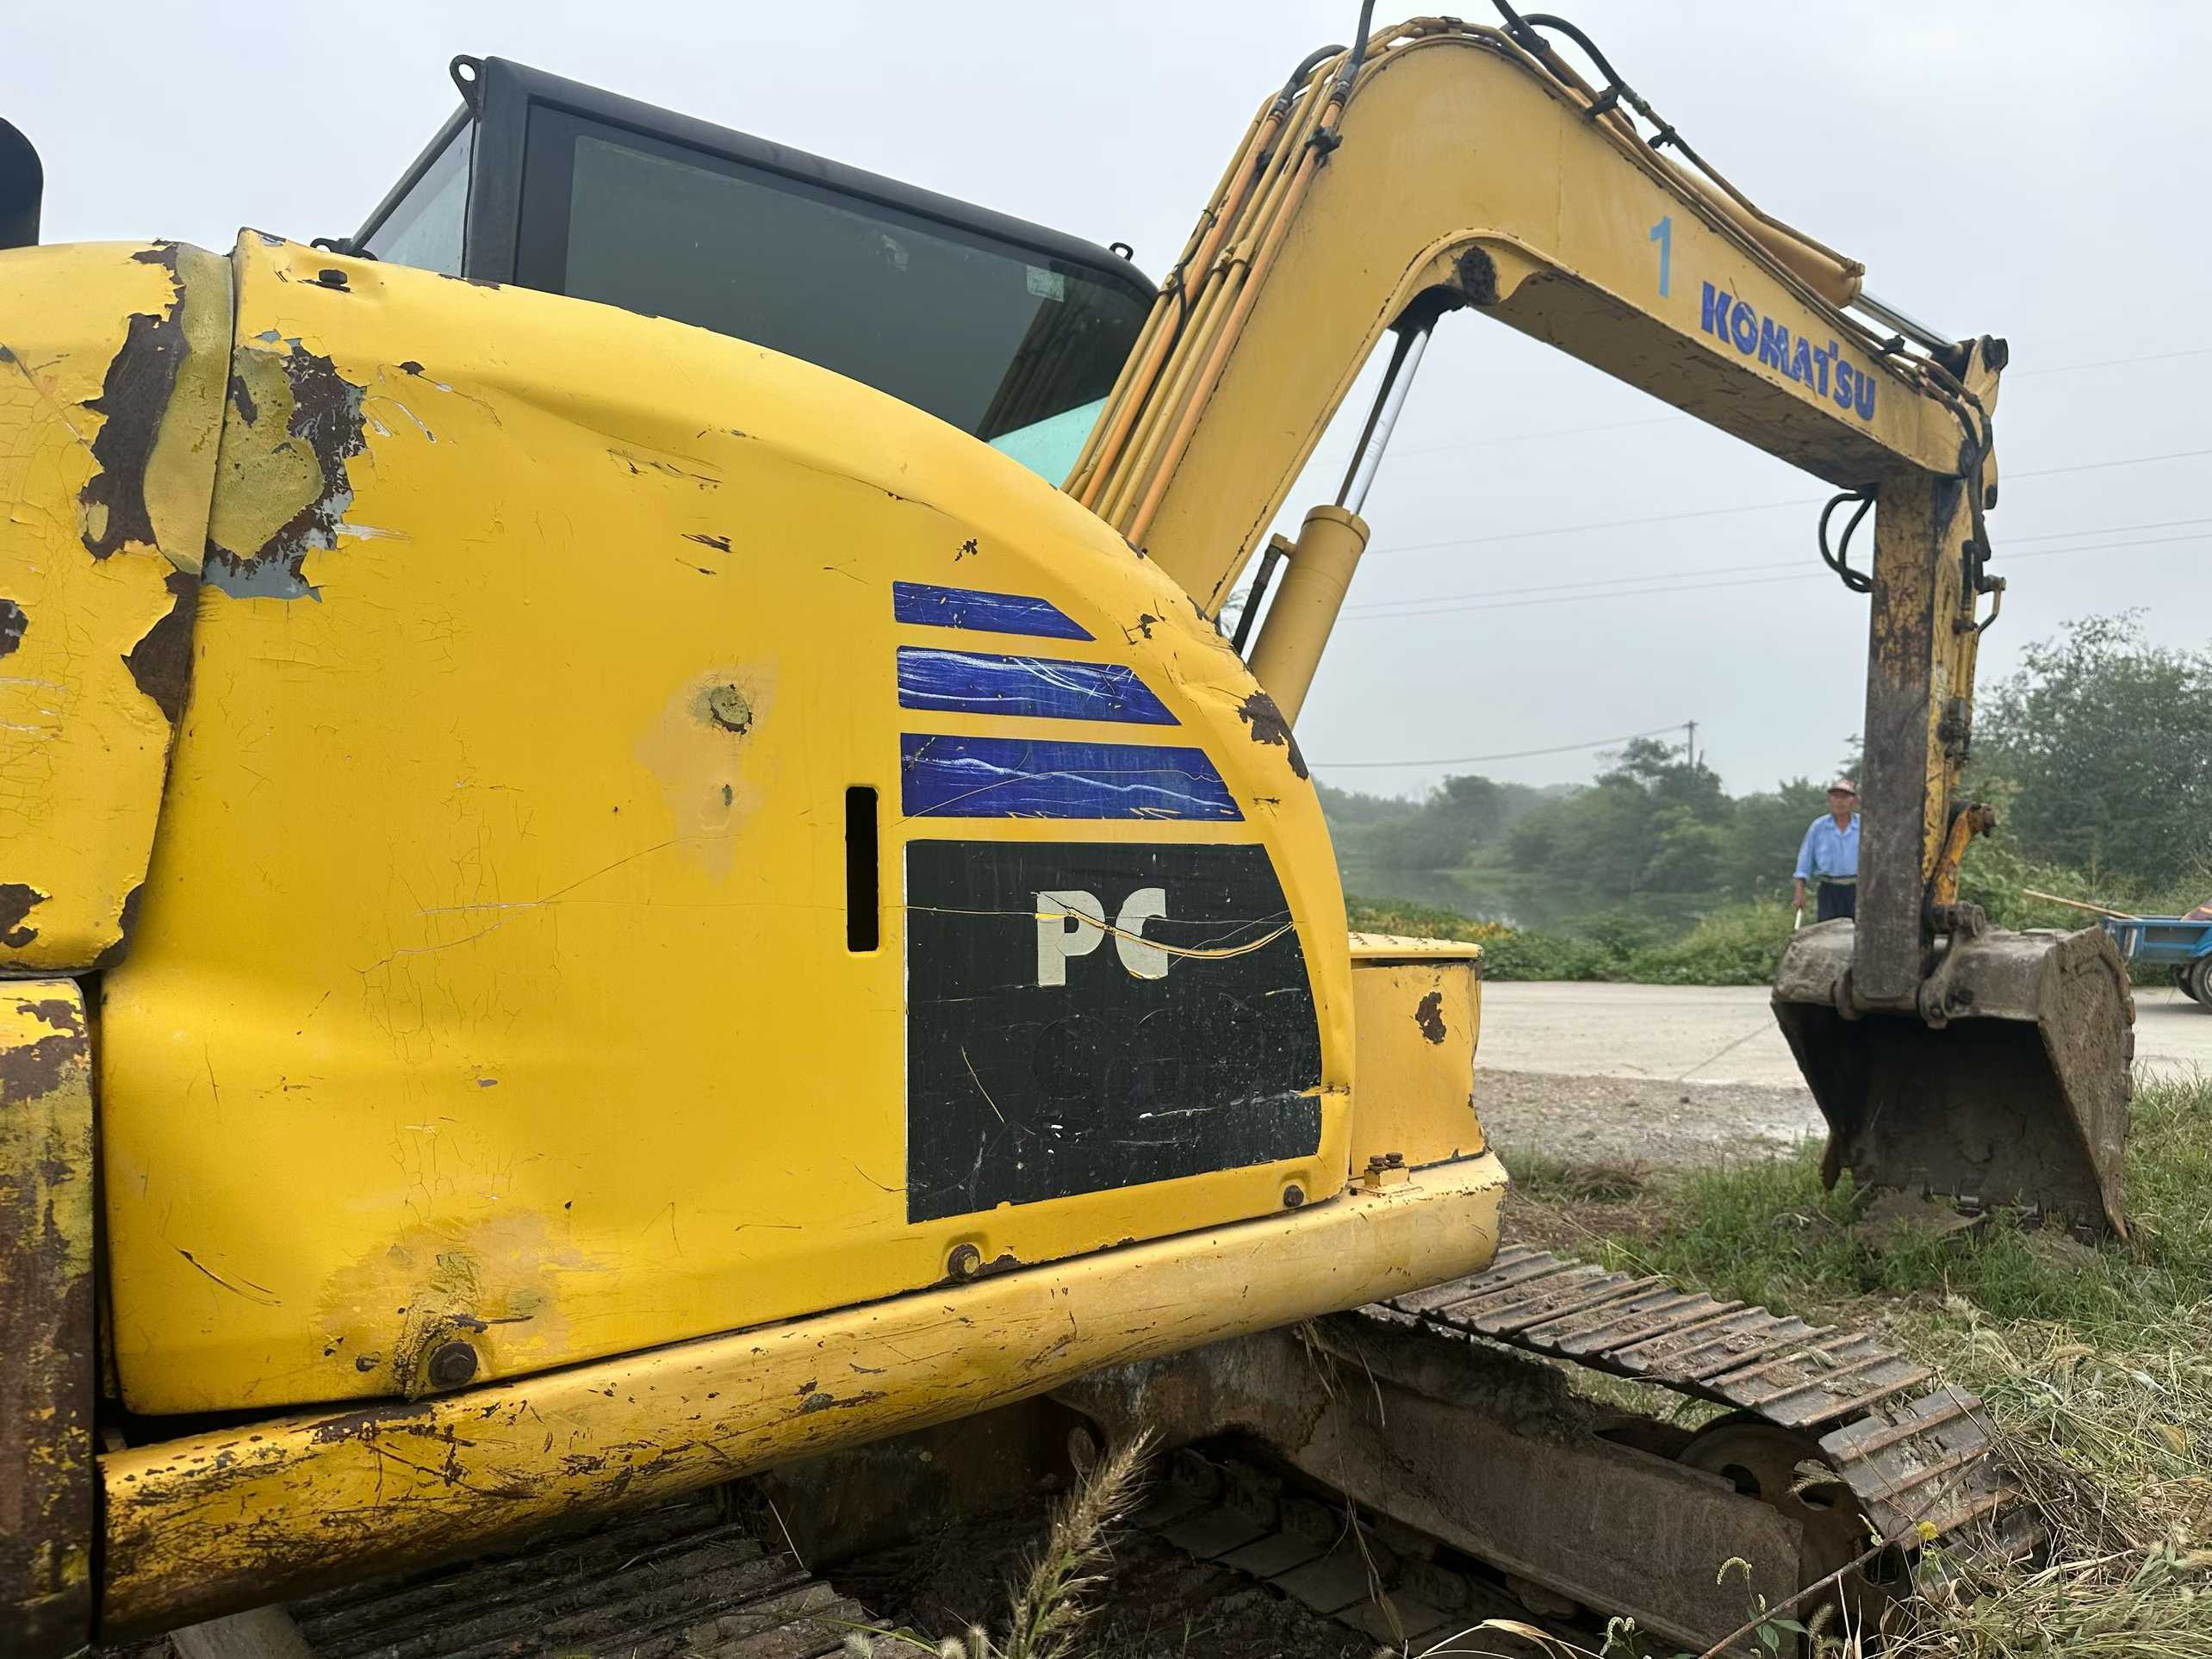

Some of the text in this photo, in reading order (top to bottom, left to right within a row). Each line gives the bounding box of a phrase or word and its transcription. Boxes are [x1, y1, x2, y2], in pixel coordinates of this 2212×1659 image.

[1650, 215, 1672, 298] 1
[1700, 280, 1875, 421] KOMATSU
[1035, 887, 1169, 986] PC
